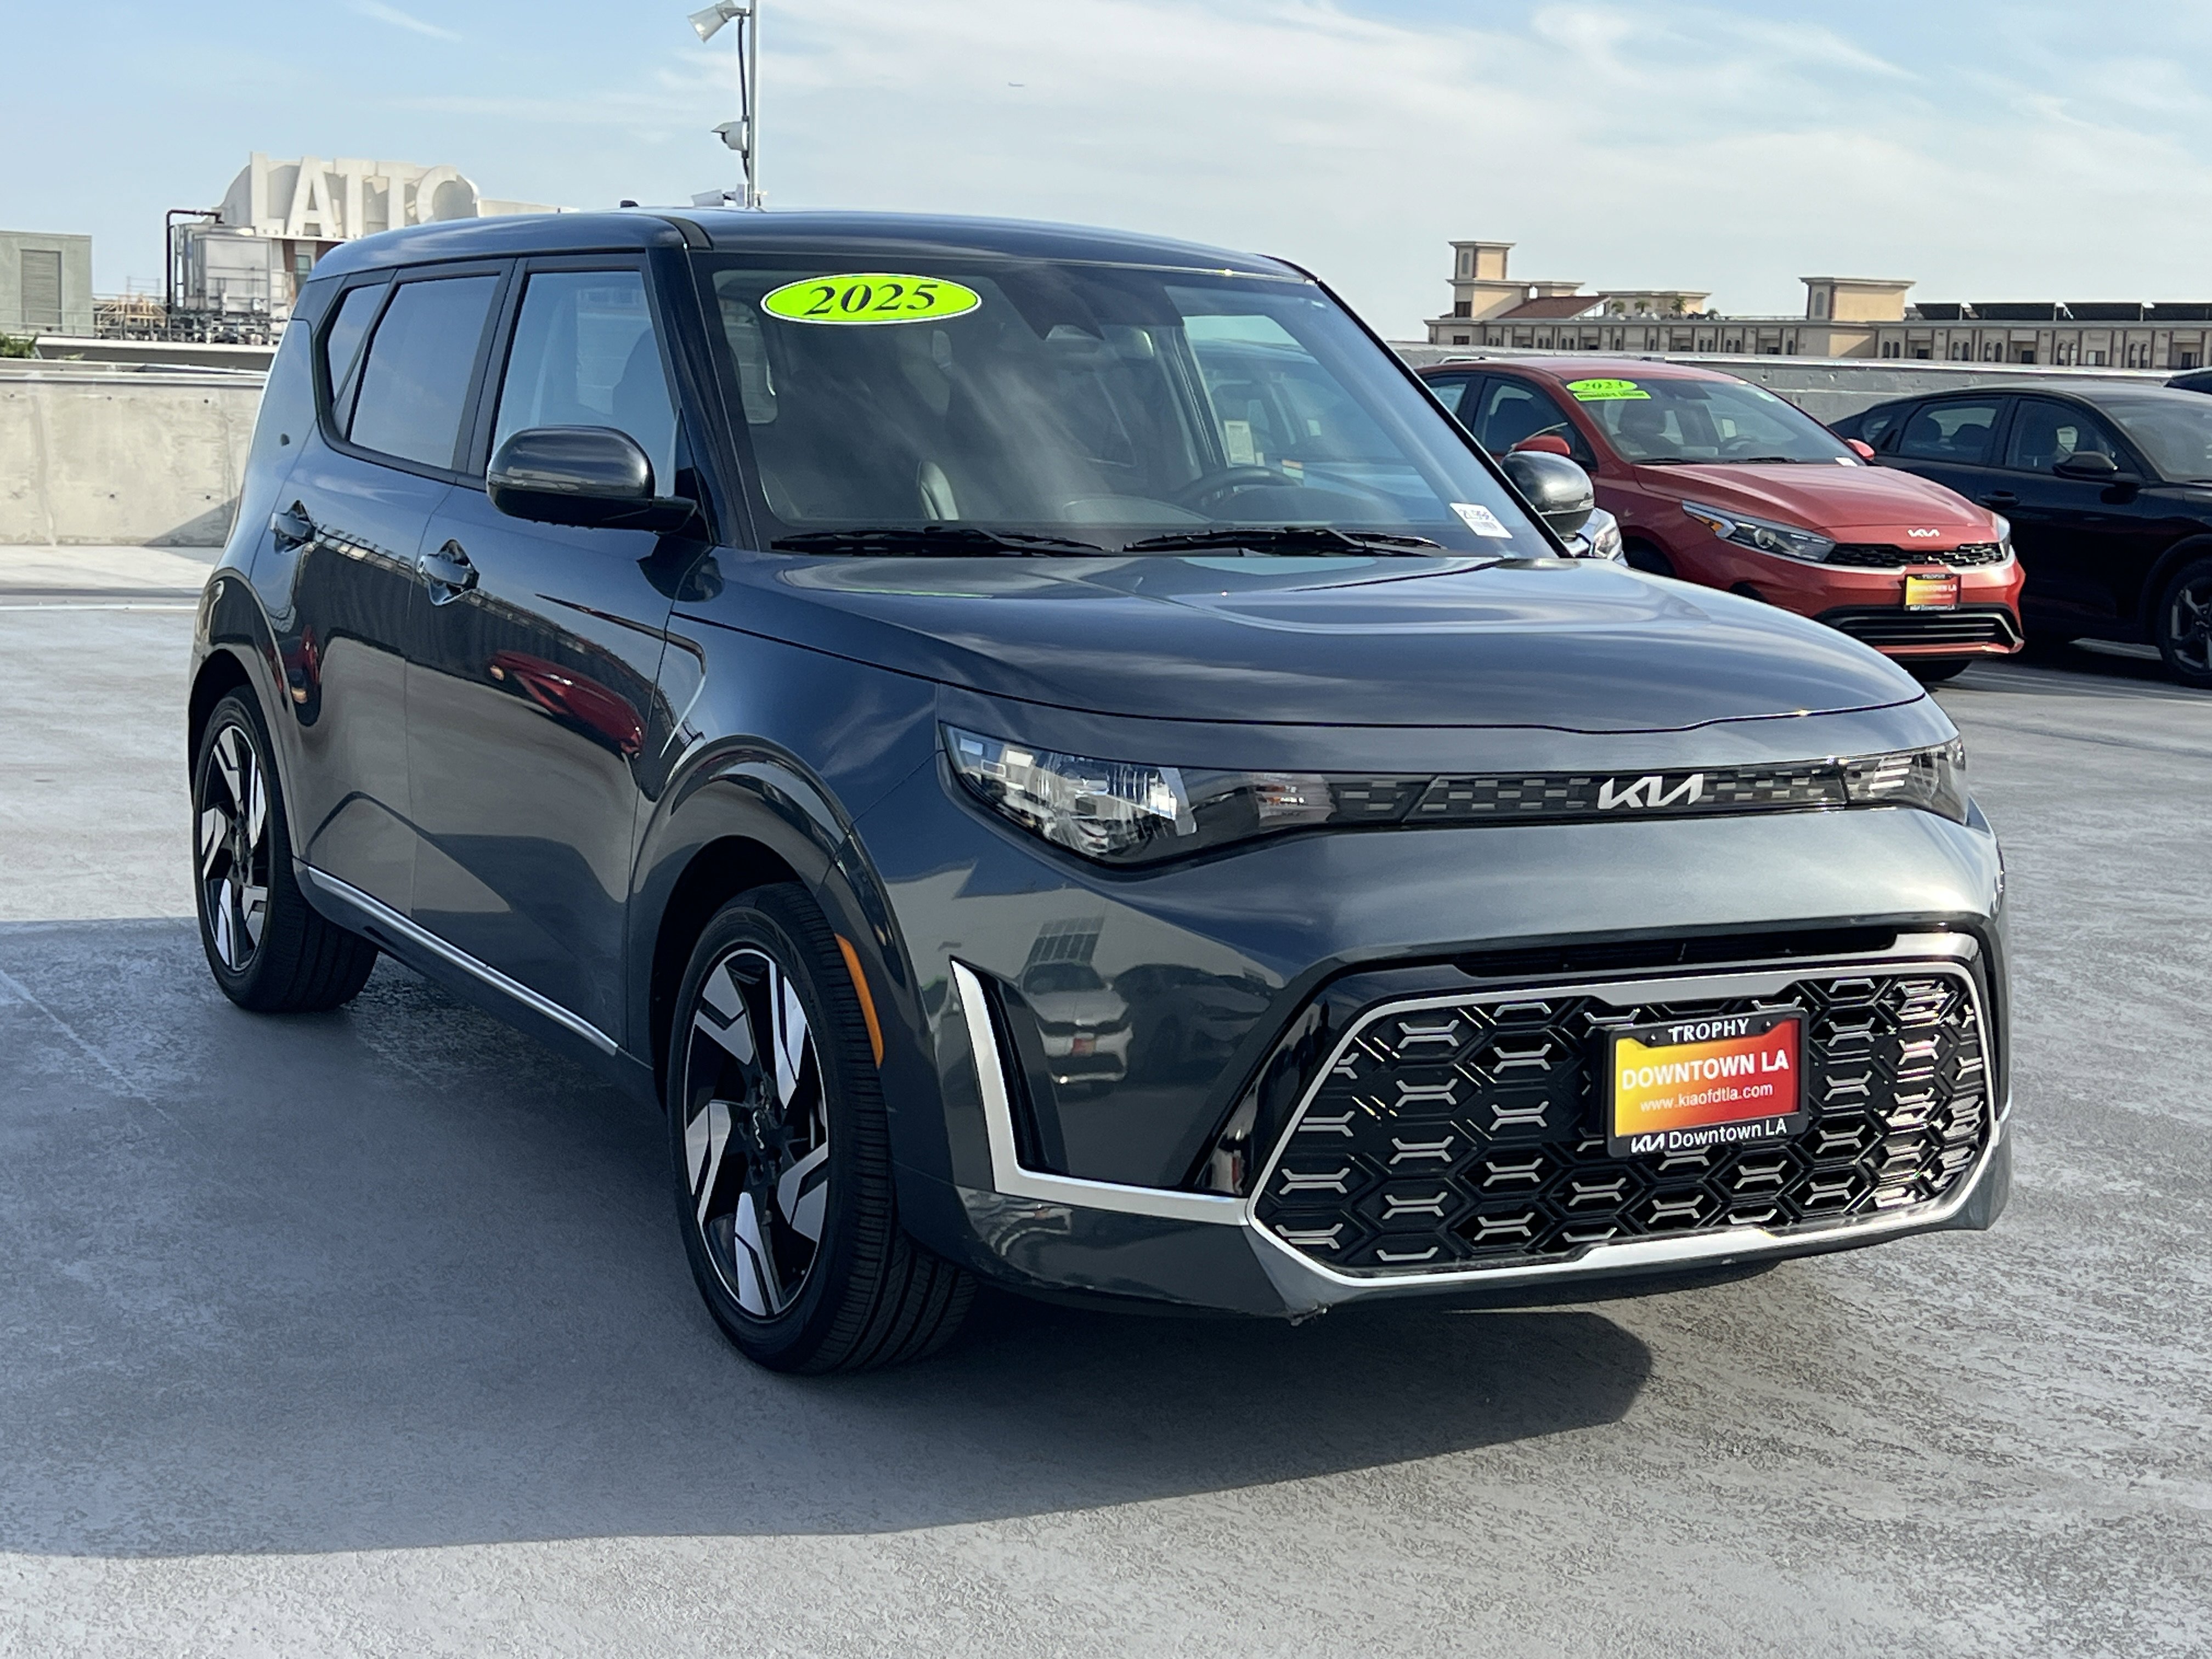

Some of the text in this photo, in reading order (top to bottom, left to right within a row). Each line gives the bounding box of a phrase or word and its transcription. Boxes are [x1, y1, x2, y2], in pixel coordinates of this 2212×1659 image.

[803, 284, 939, 316] 2025
[1597, 774, 1703, 809] KIA
[1668, 1018, 1750, 1042] TROPHY
[1622, 1049, 1789, 1091] DOWNTOWN LA
[1640, 1084, 1773, 1113] www.kiaofdtla.com
[1669, 1123, 1762, 1149] Downtown
[1765, 1118, 1787, 1136] LA
